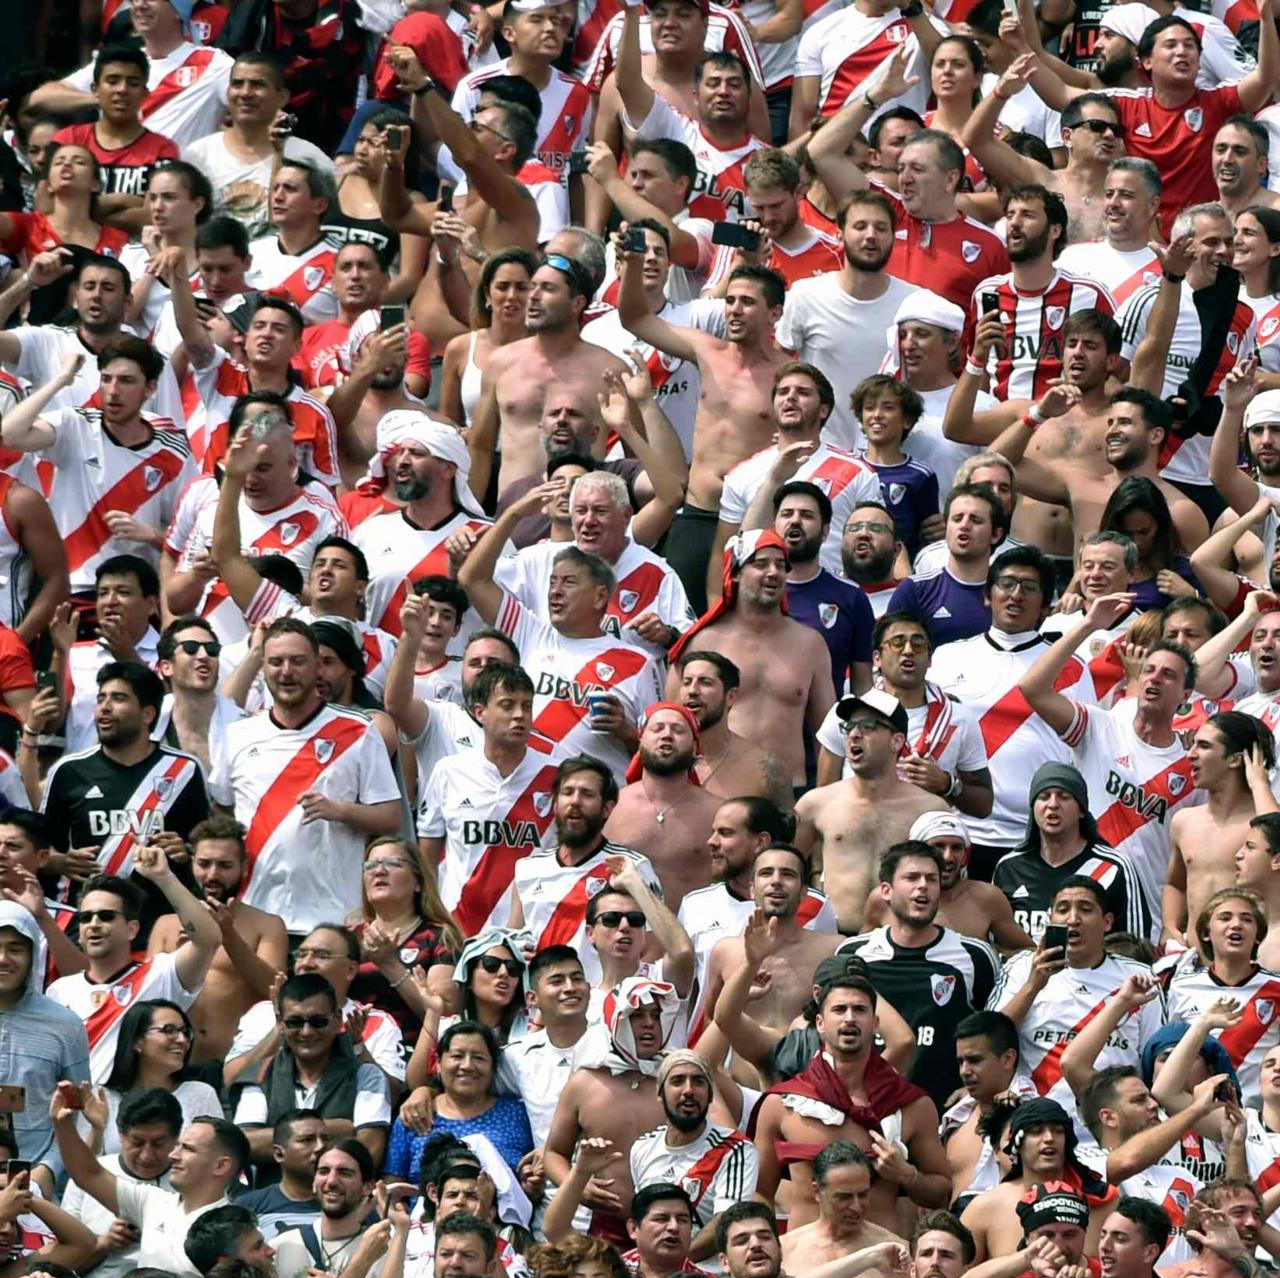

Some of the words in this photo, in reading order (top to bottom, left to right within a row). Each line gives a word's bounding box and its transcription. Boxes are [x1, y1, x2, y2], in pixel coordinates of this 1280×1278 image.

[1105, 770, 1167, 825] BBVA
[89, 811, 163, 835] BBVA
[463, 820, 540, 847] BBVA
[917, 1026, 933, 1045] 18
